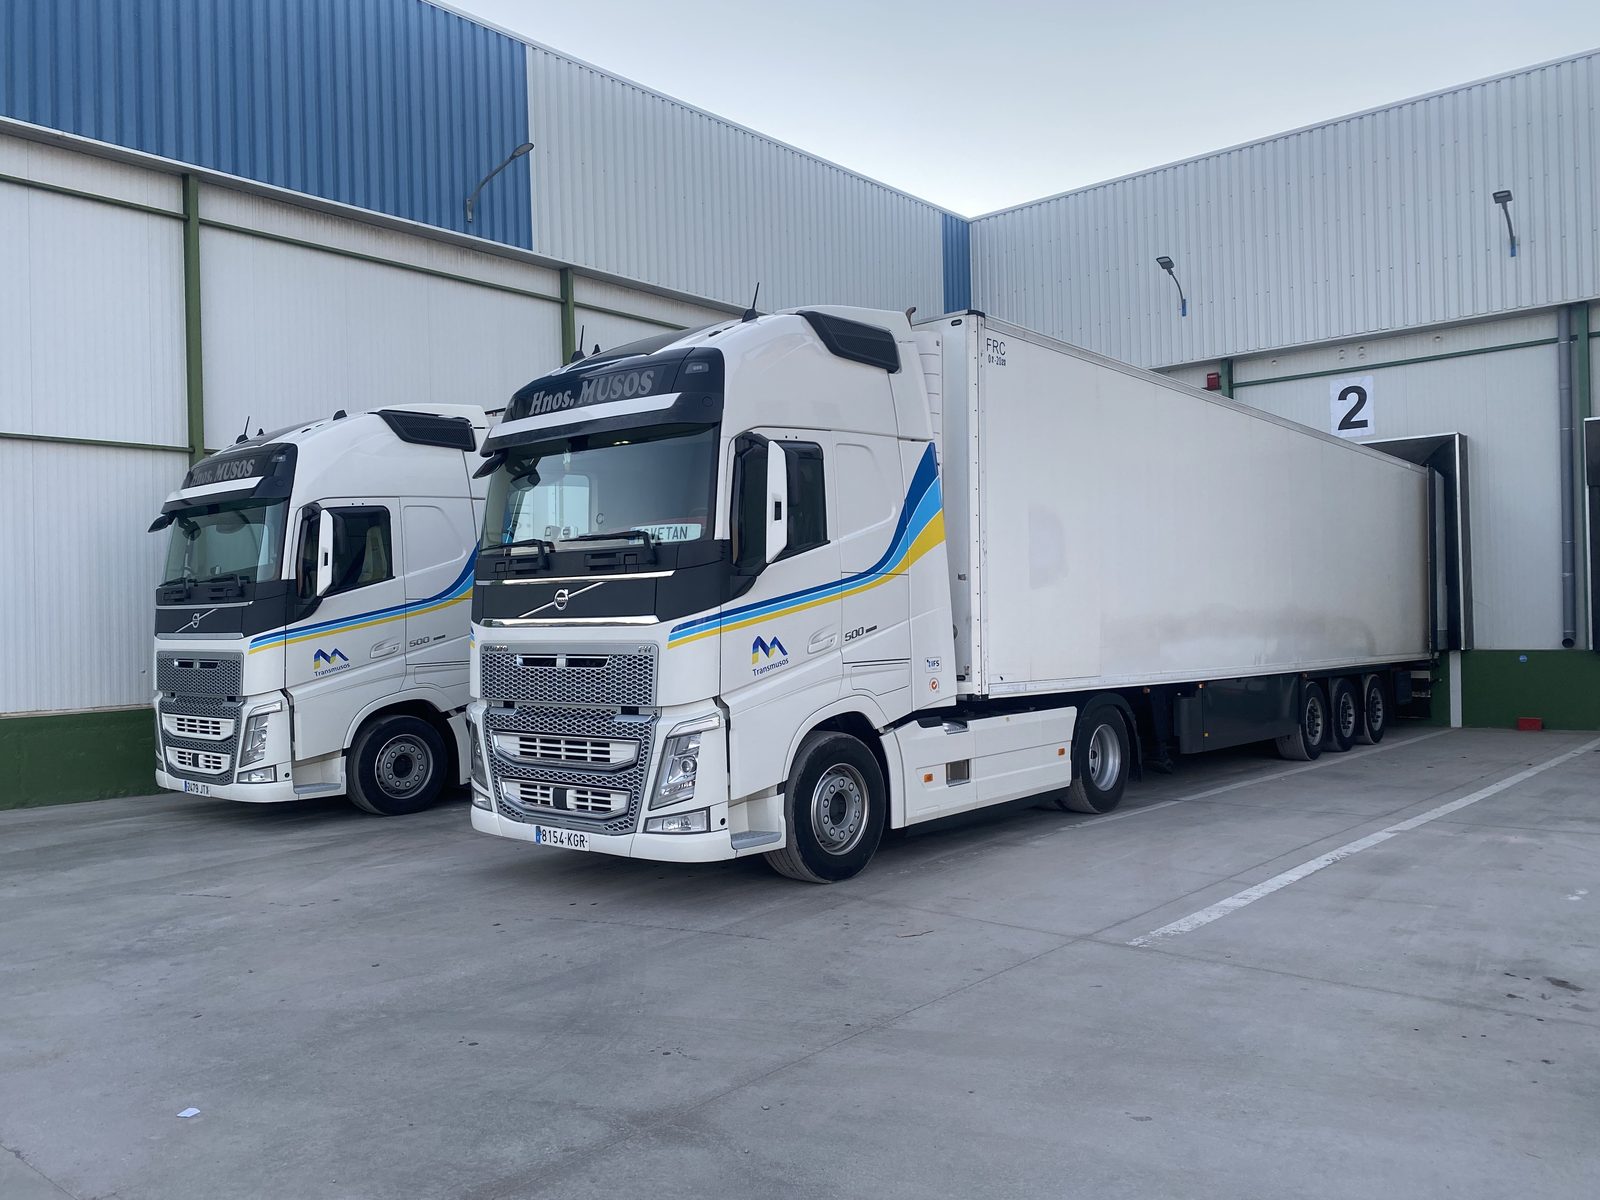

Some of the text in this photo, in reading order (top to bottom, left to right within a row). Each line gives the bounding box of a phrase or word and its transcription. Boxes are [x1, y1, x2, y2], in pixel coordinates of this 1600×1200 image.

[986, 337, 1006, 356] FRC
[528, 370, 655, 415] Hnos. MUSOS
[1337, 385, 1369, 431] 2
[214, 459, 256, 482] MUSOS
[635, 526, 688, 542] VETAN
[409, 636, 430, 648] 500
[845, 626, 864, 642] 500
[314, 663, 351, 677] Transmusos
[752, 658, 789, 676] Transmusos
[541, 828, 565, 846] 8154
[567, 833, 586, 849] KGR
